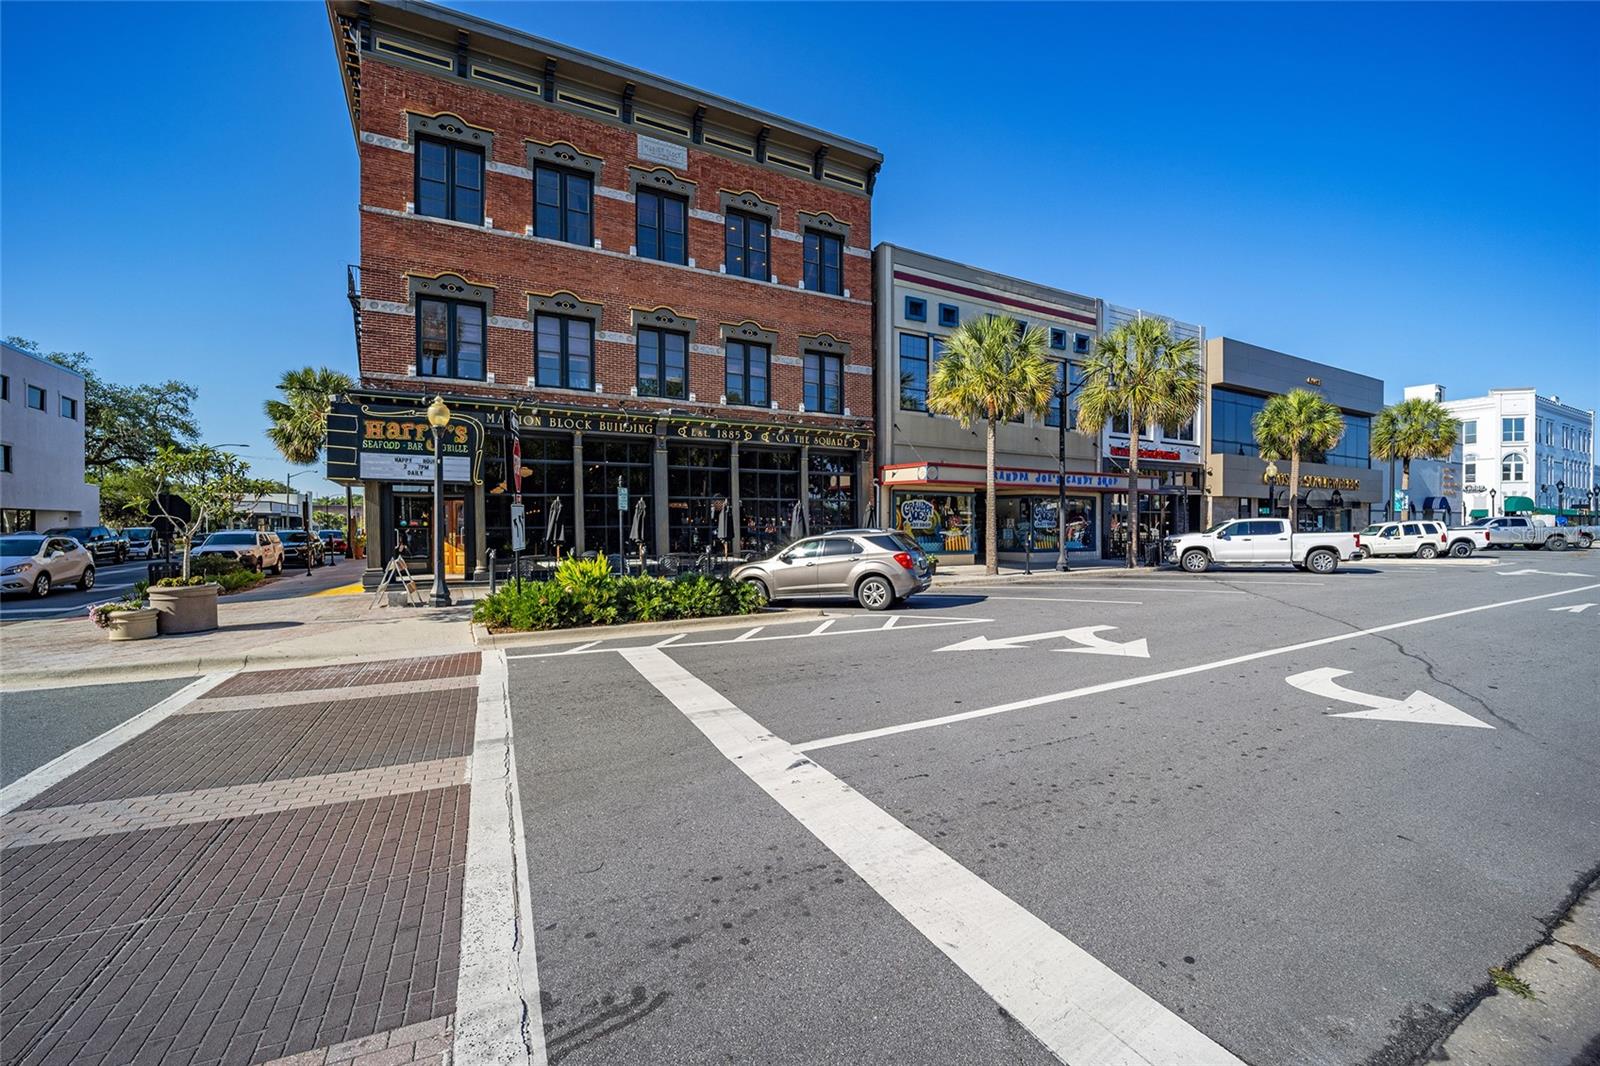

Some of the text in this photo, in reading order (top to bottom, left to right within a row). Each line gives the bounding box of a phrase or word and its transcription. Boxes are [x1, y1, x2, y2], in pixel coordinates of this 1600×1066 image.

[486, 412, 541, 426] MAION
[549, 418, 592, 430] BLOCK
[599, 421, 653, 434] BUILDING
[717, 430, 740, 439] 1885
[794, 434, 810, 445] THE
[362, 439, 401, 450] SEAFOOD
[407, 441, 423, 451] BAR
[1066, 475, 1093, 486] CANDY
